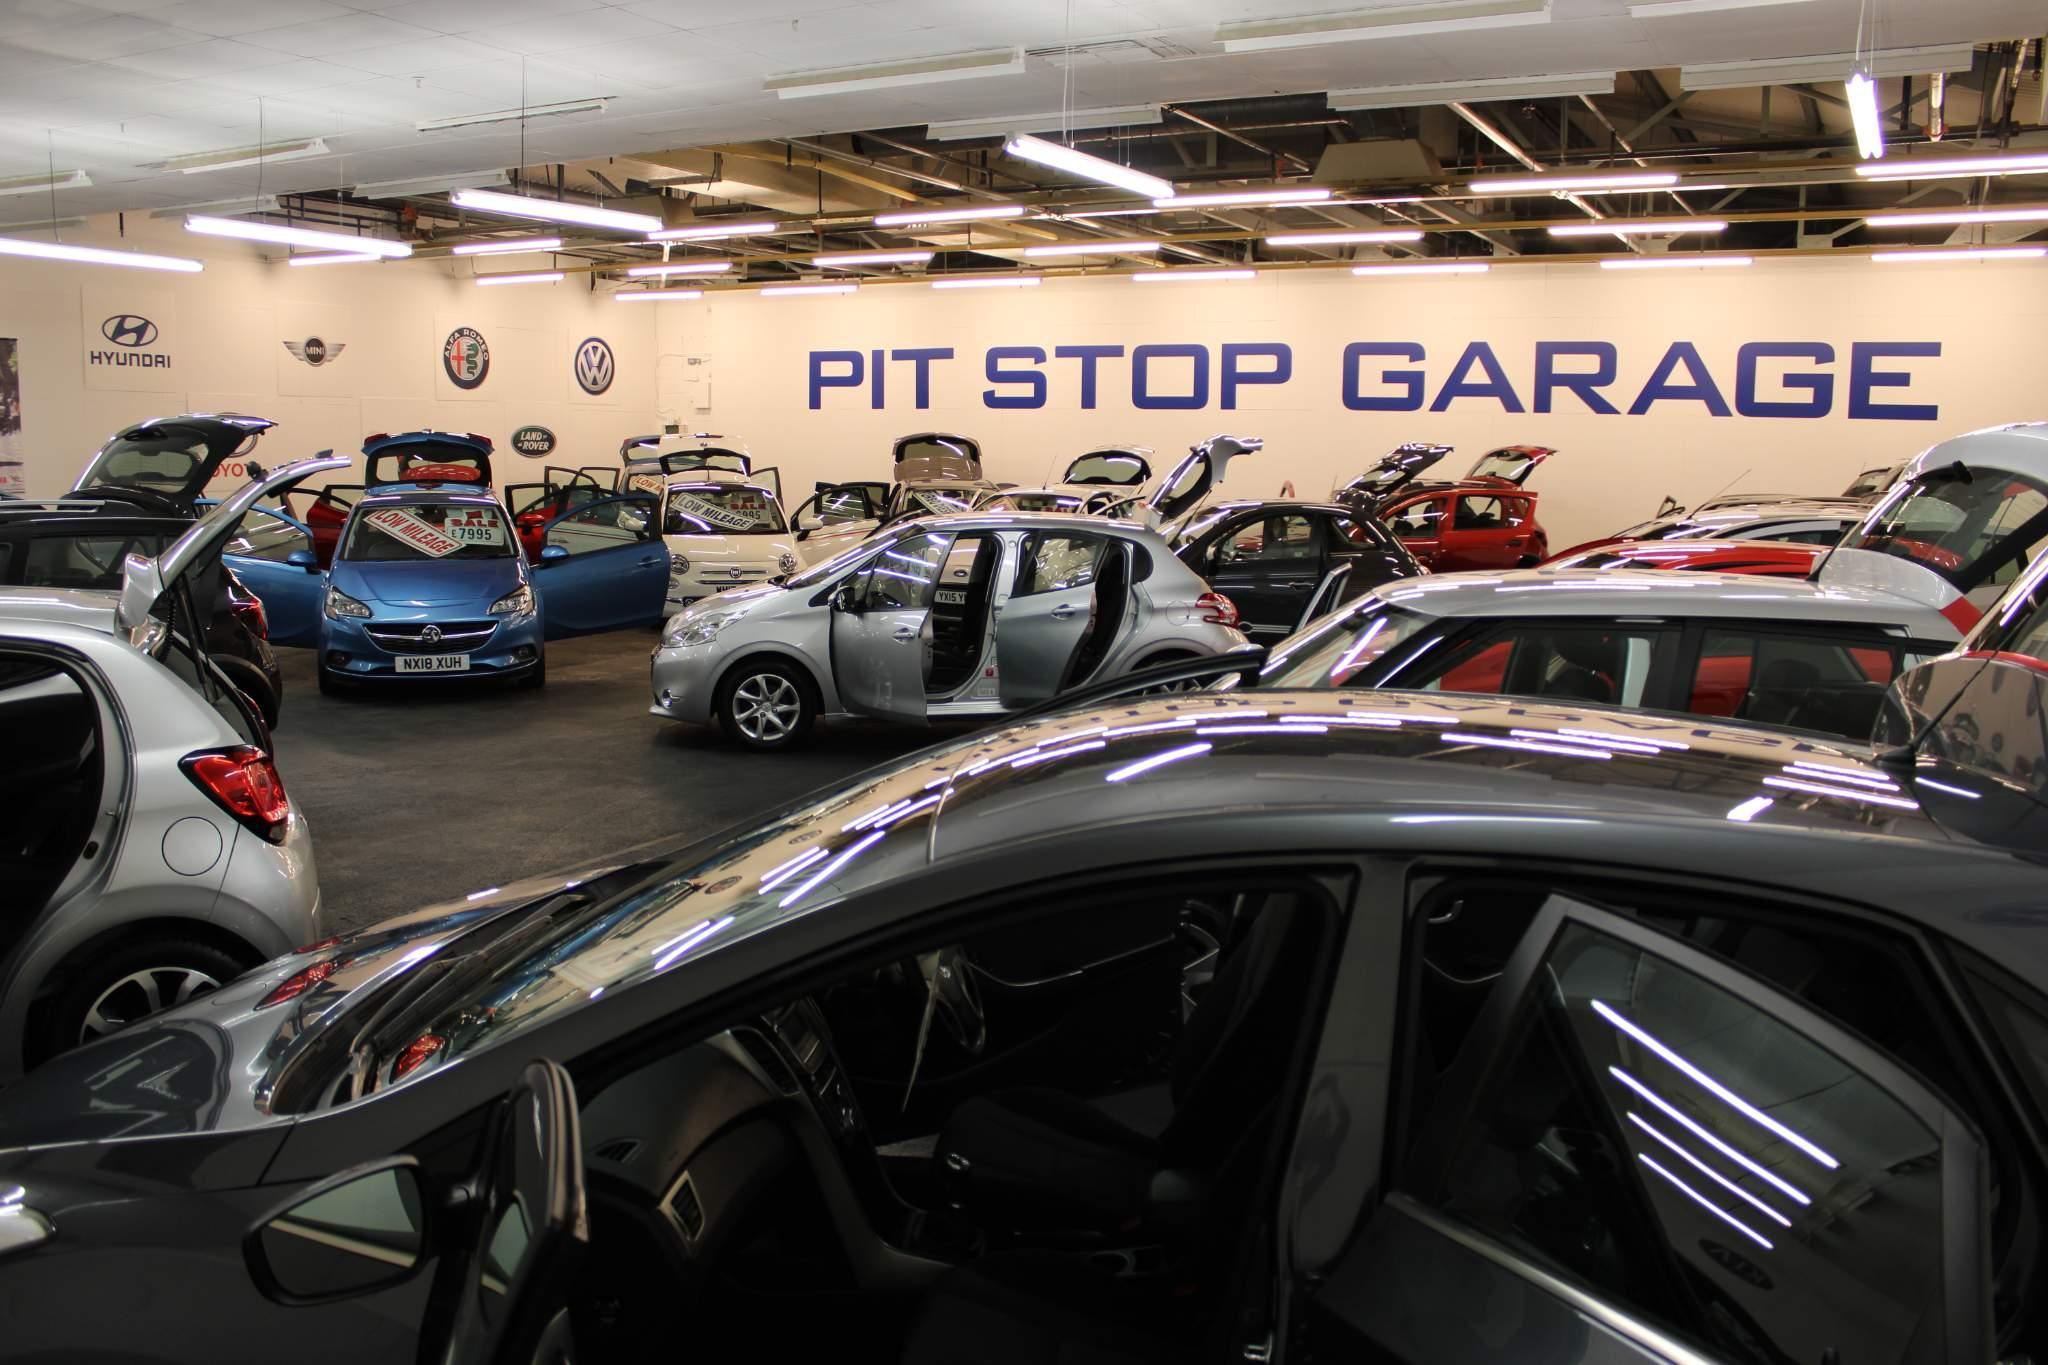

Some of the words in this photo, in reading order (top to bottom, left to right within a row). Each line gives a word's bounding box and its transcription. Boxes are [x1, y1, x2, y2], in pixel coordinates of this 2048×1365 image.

[305, 346, 325, 355] MINI
[445, 332, 460, 358] ALFA
[463, 329, 489, 360] ROMEO
[90, 350, 171, 369] HYUNDAI
[808, 347, 955, 410] PIT
[982, 342, 1292, 410] STOP
[1342, 341, 1942, 420] GARAGE
[520, 431, 543, 441] LAND
[522, 441, 550, 451] ROVER
[678, 496, 703, 513] LOW
[701, 506, 751, 528] MILEAGE
[450, 518, 499, 528] SALE
[374, 508, 406, 529] LOW
[399, 522, 456, 553] MILEAGE
[939, 591, 957, 601] YX15
[404, 657, 433, 670] NX18
[436, 656, 462, 669] XUH
